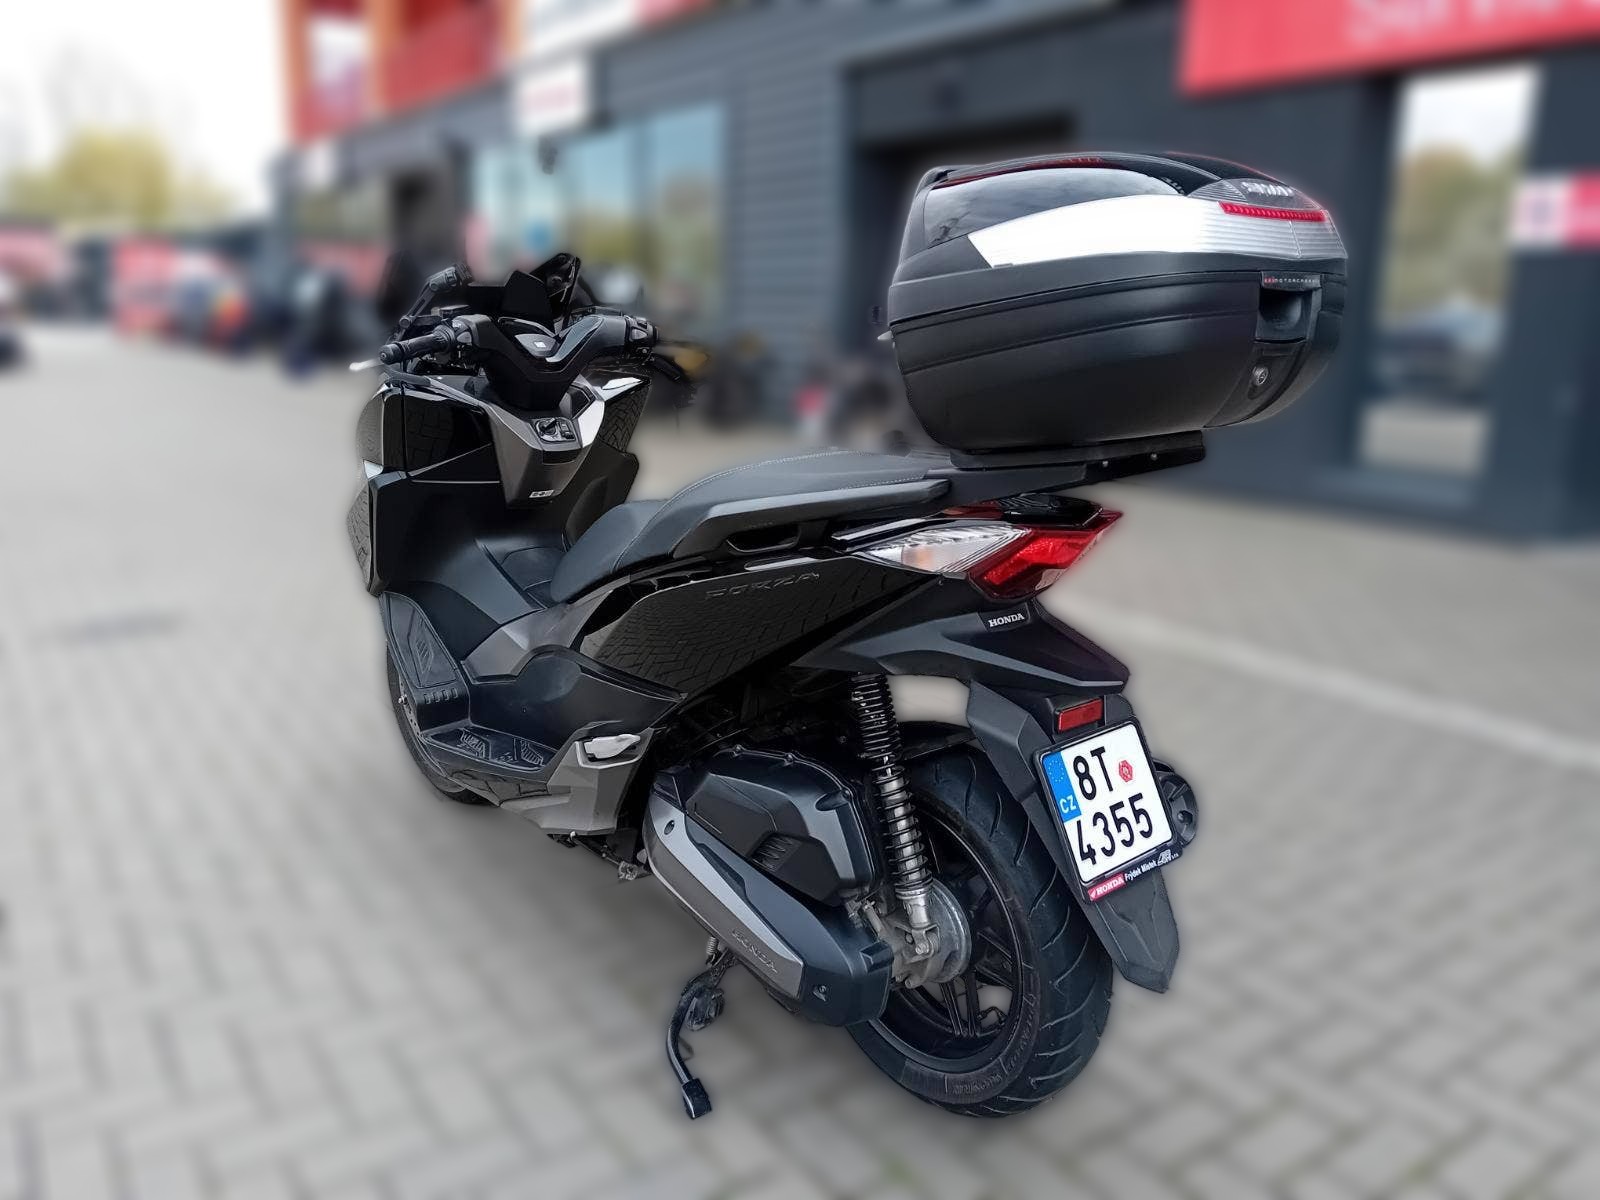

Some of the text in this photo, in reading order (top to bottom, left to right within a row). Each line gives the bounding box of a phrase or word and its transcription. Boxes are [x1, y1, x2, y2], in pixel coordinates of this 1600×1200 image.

[988, 613, 1025, 627] HONDA
[1073, 746, 1114, 800] 8T
[1059, 794, 1077, 814] CZ
[1077, 792, 1153, 865] 4355
[1096, 876, 1125, 894] HONDA
[731, 928, 777, 973] HONDA
